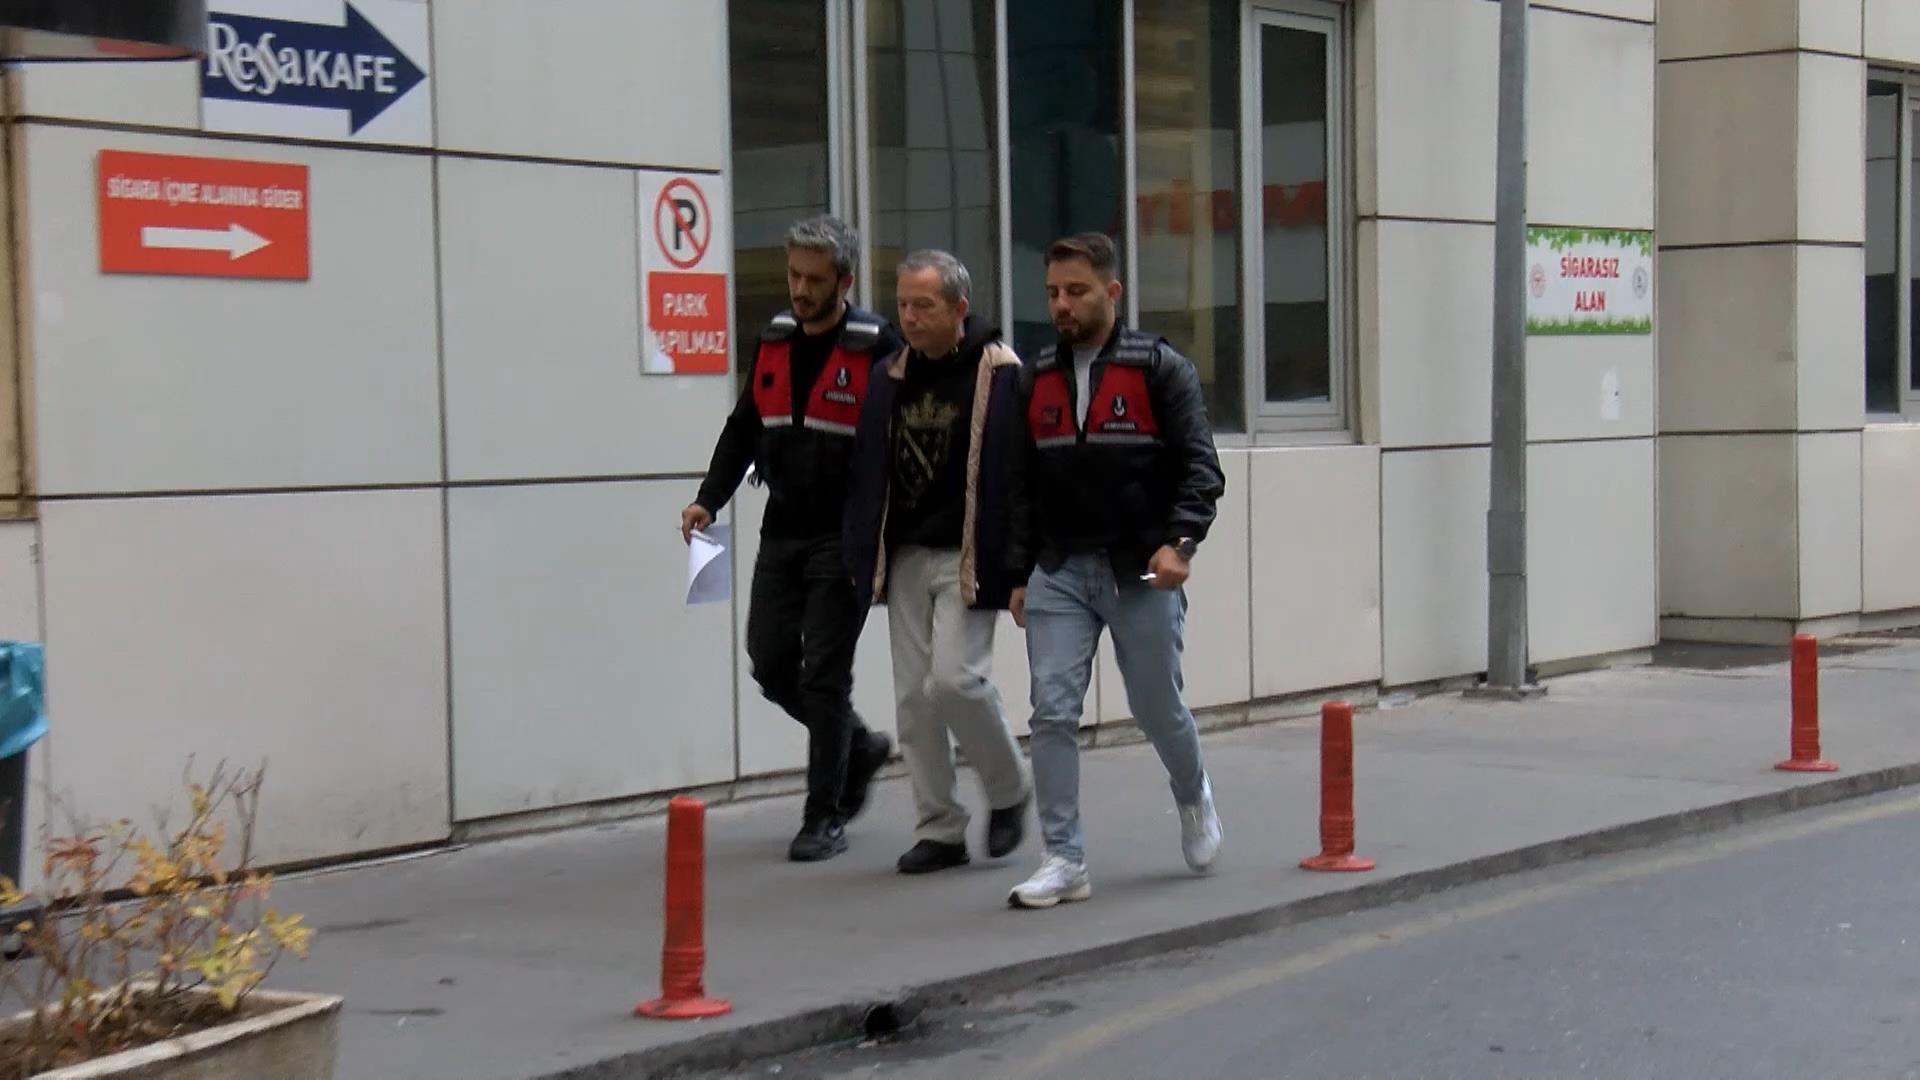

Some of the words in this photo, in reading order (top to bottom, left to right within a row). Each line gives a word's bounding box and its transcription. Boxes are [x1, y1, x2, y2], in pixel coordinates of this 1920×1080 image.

[306, 49, 397, 93] KAFE
[1560, 251, 1619, 278] SİGARASIZ
[663, 292, 709, 317] PARK
[1574, 291, 1605, 312] ALAN
